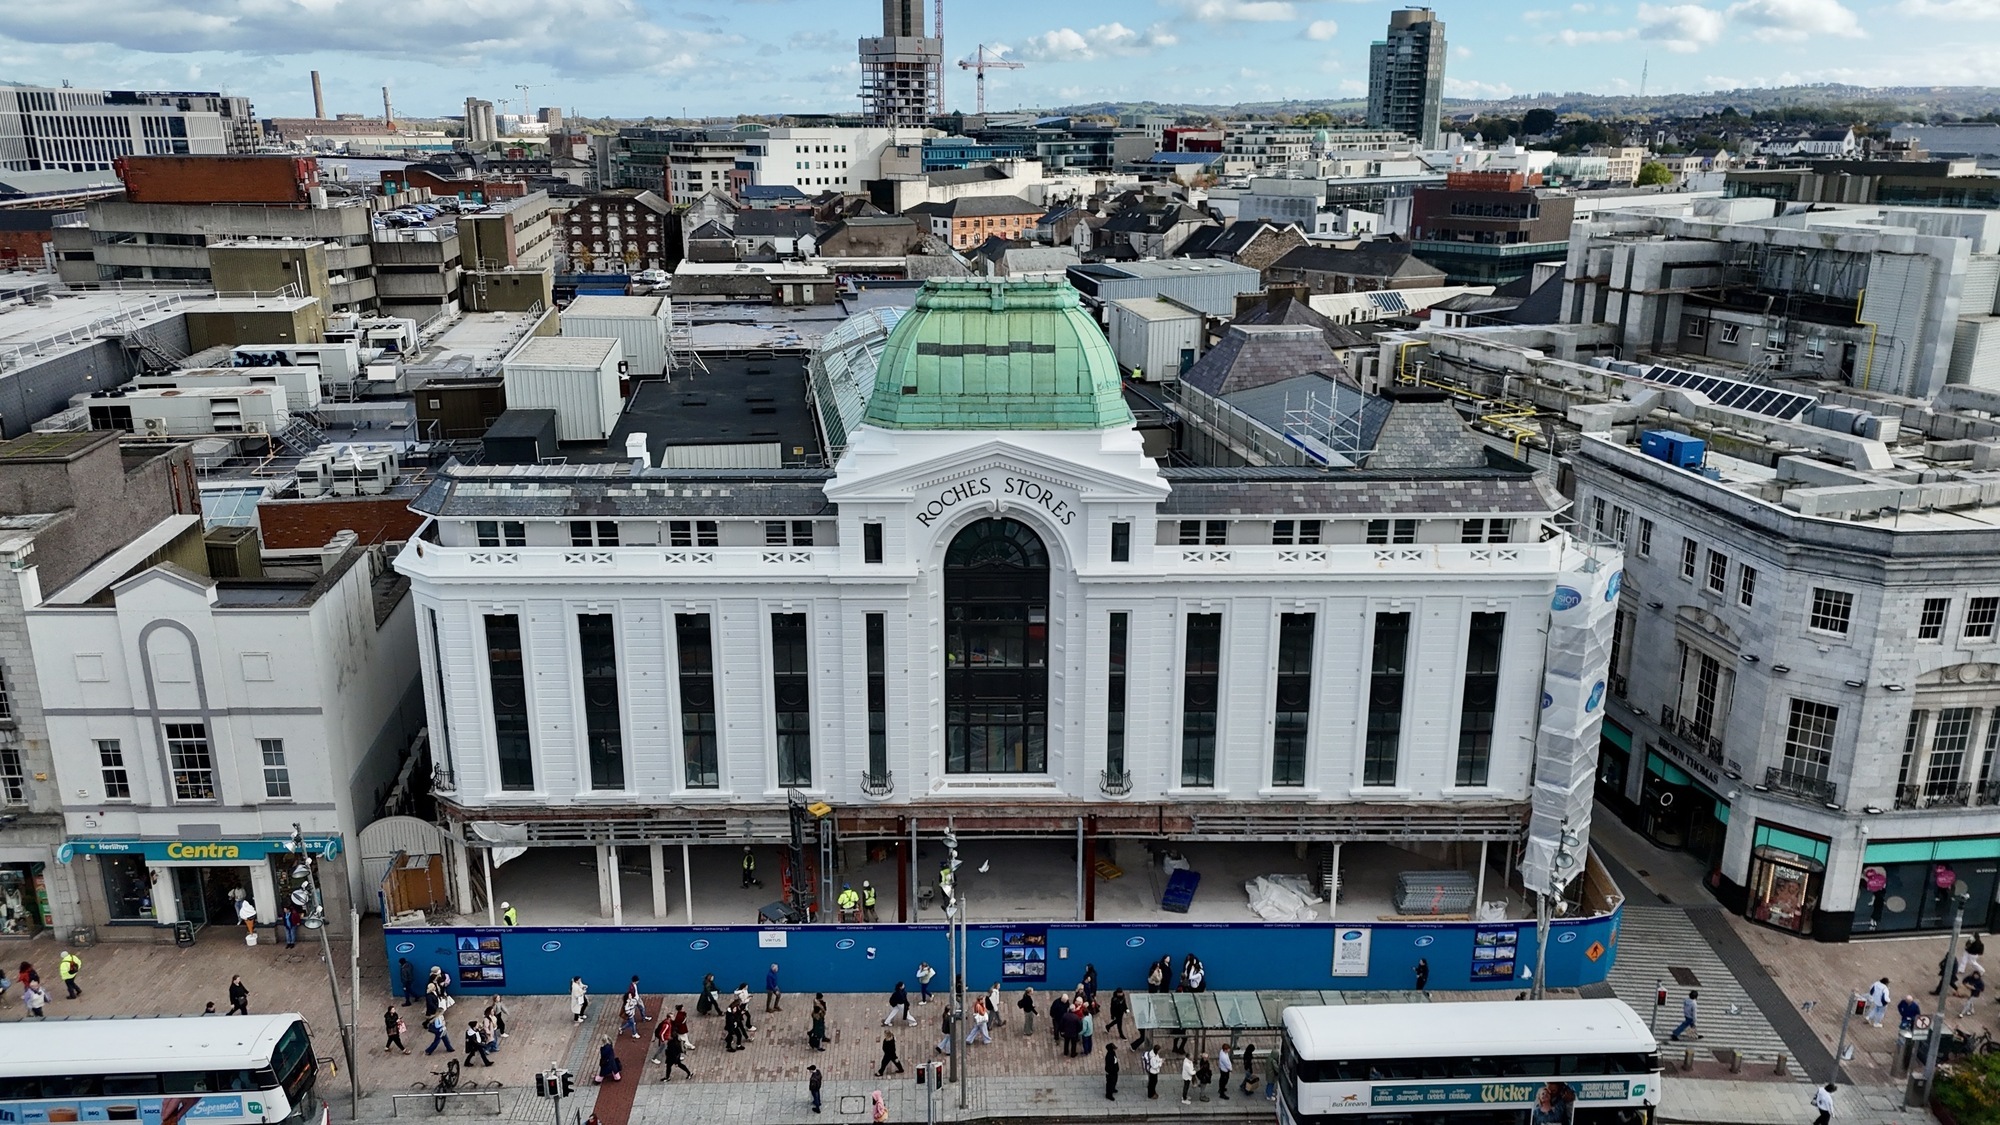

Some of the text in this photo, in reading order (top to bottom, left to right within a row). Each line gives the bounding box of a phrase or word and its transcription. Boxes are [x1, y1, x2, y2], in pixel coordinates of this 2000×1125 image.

[916, 477, 1076, 528] ROCHES STORES
[1658, 736, 1685, 761] BROWN
[1686, 754, 1719, 785] THOMAS
[167, 843, 239, 858] Centra
[1481, 1084, 1533, 1102] Wicker
